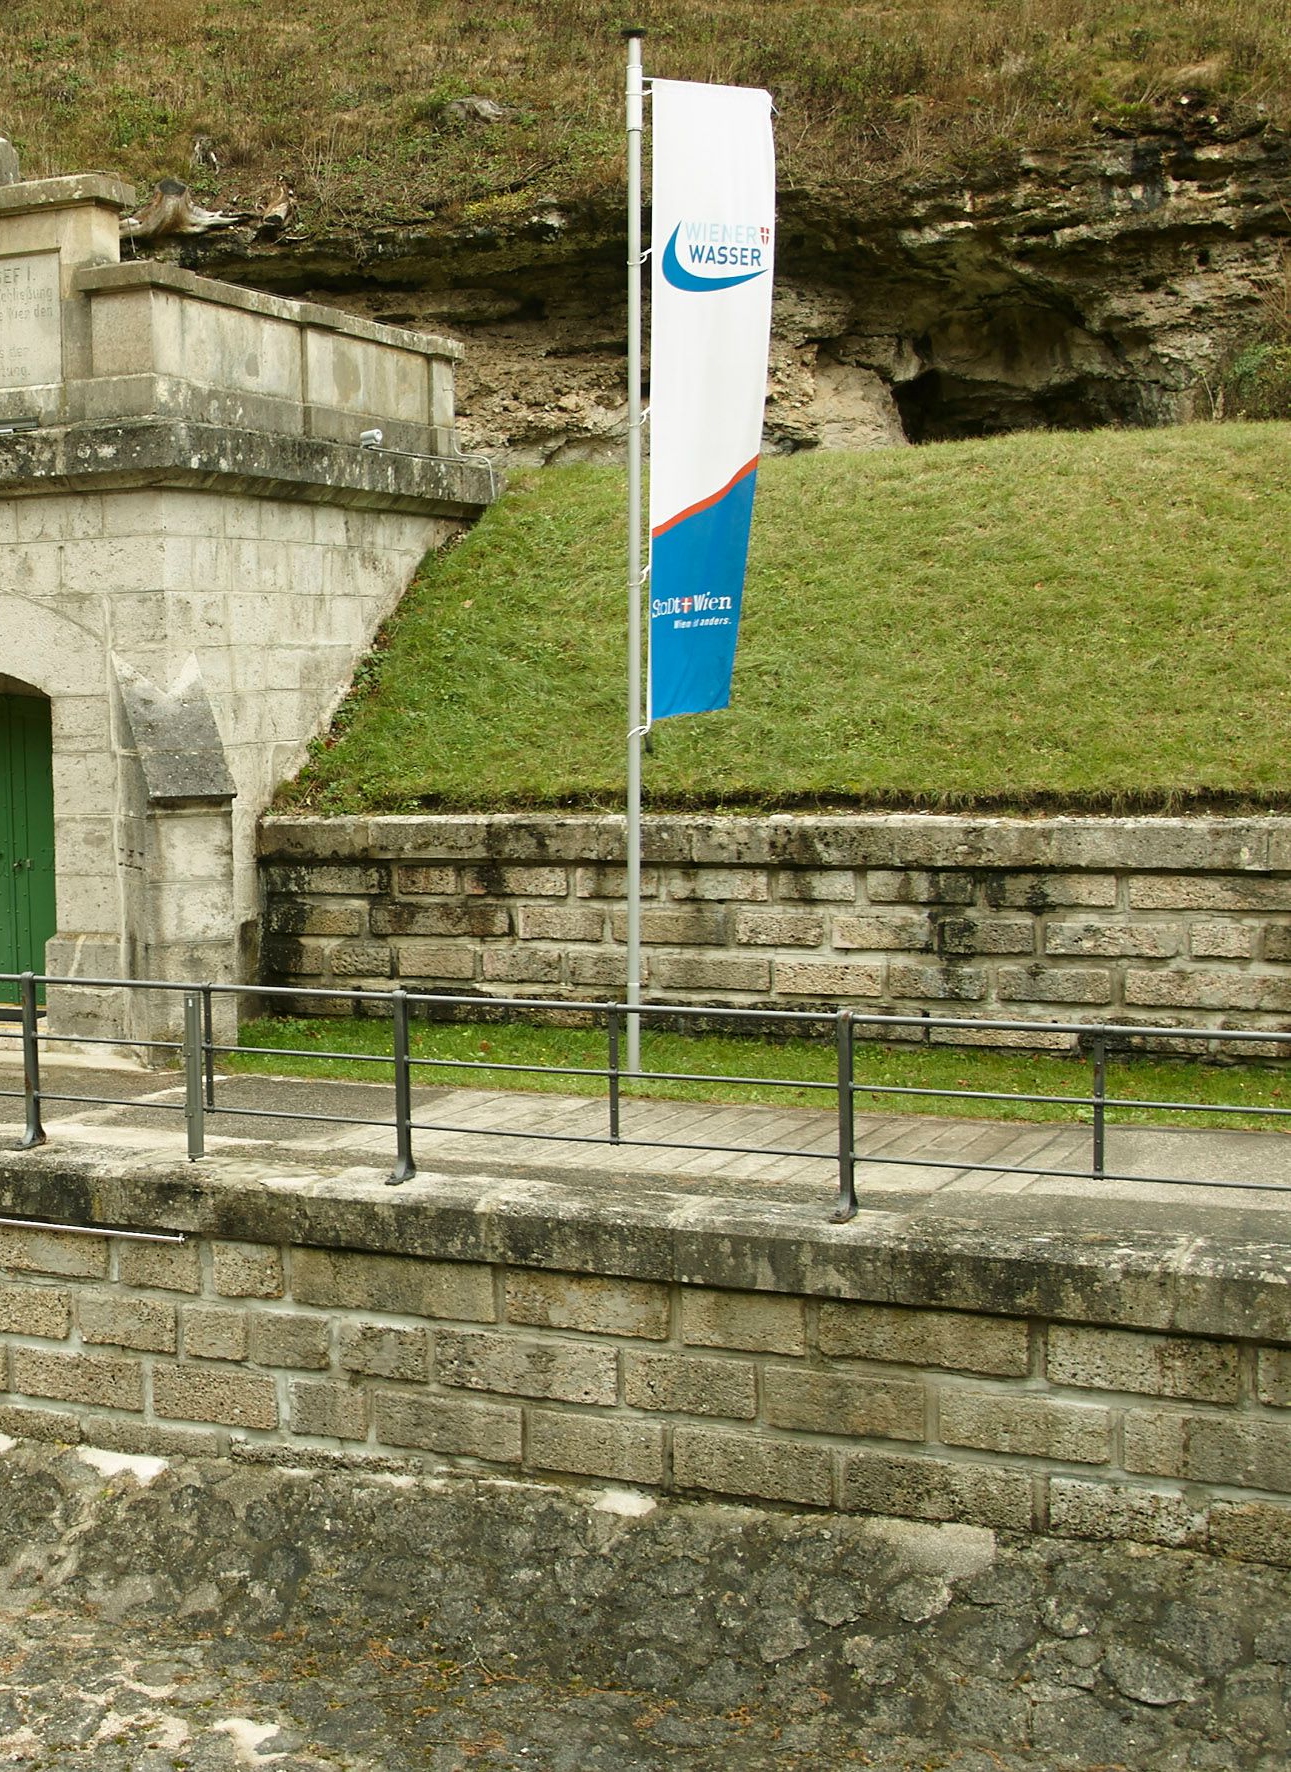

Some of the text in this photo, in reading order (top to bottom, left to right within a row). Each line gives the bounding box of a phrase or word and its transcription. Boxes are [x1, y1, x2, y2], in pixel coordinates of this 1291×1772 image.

[685, 222, 757, 244] WIENER
[688, 244, 761, 266] WASSER
[33, 303, 53, 318] den
[693, 592, 732, 612] Wien
[699, 616, 732, 627] anders.
